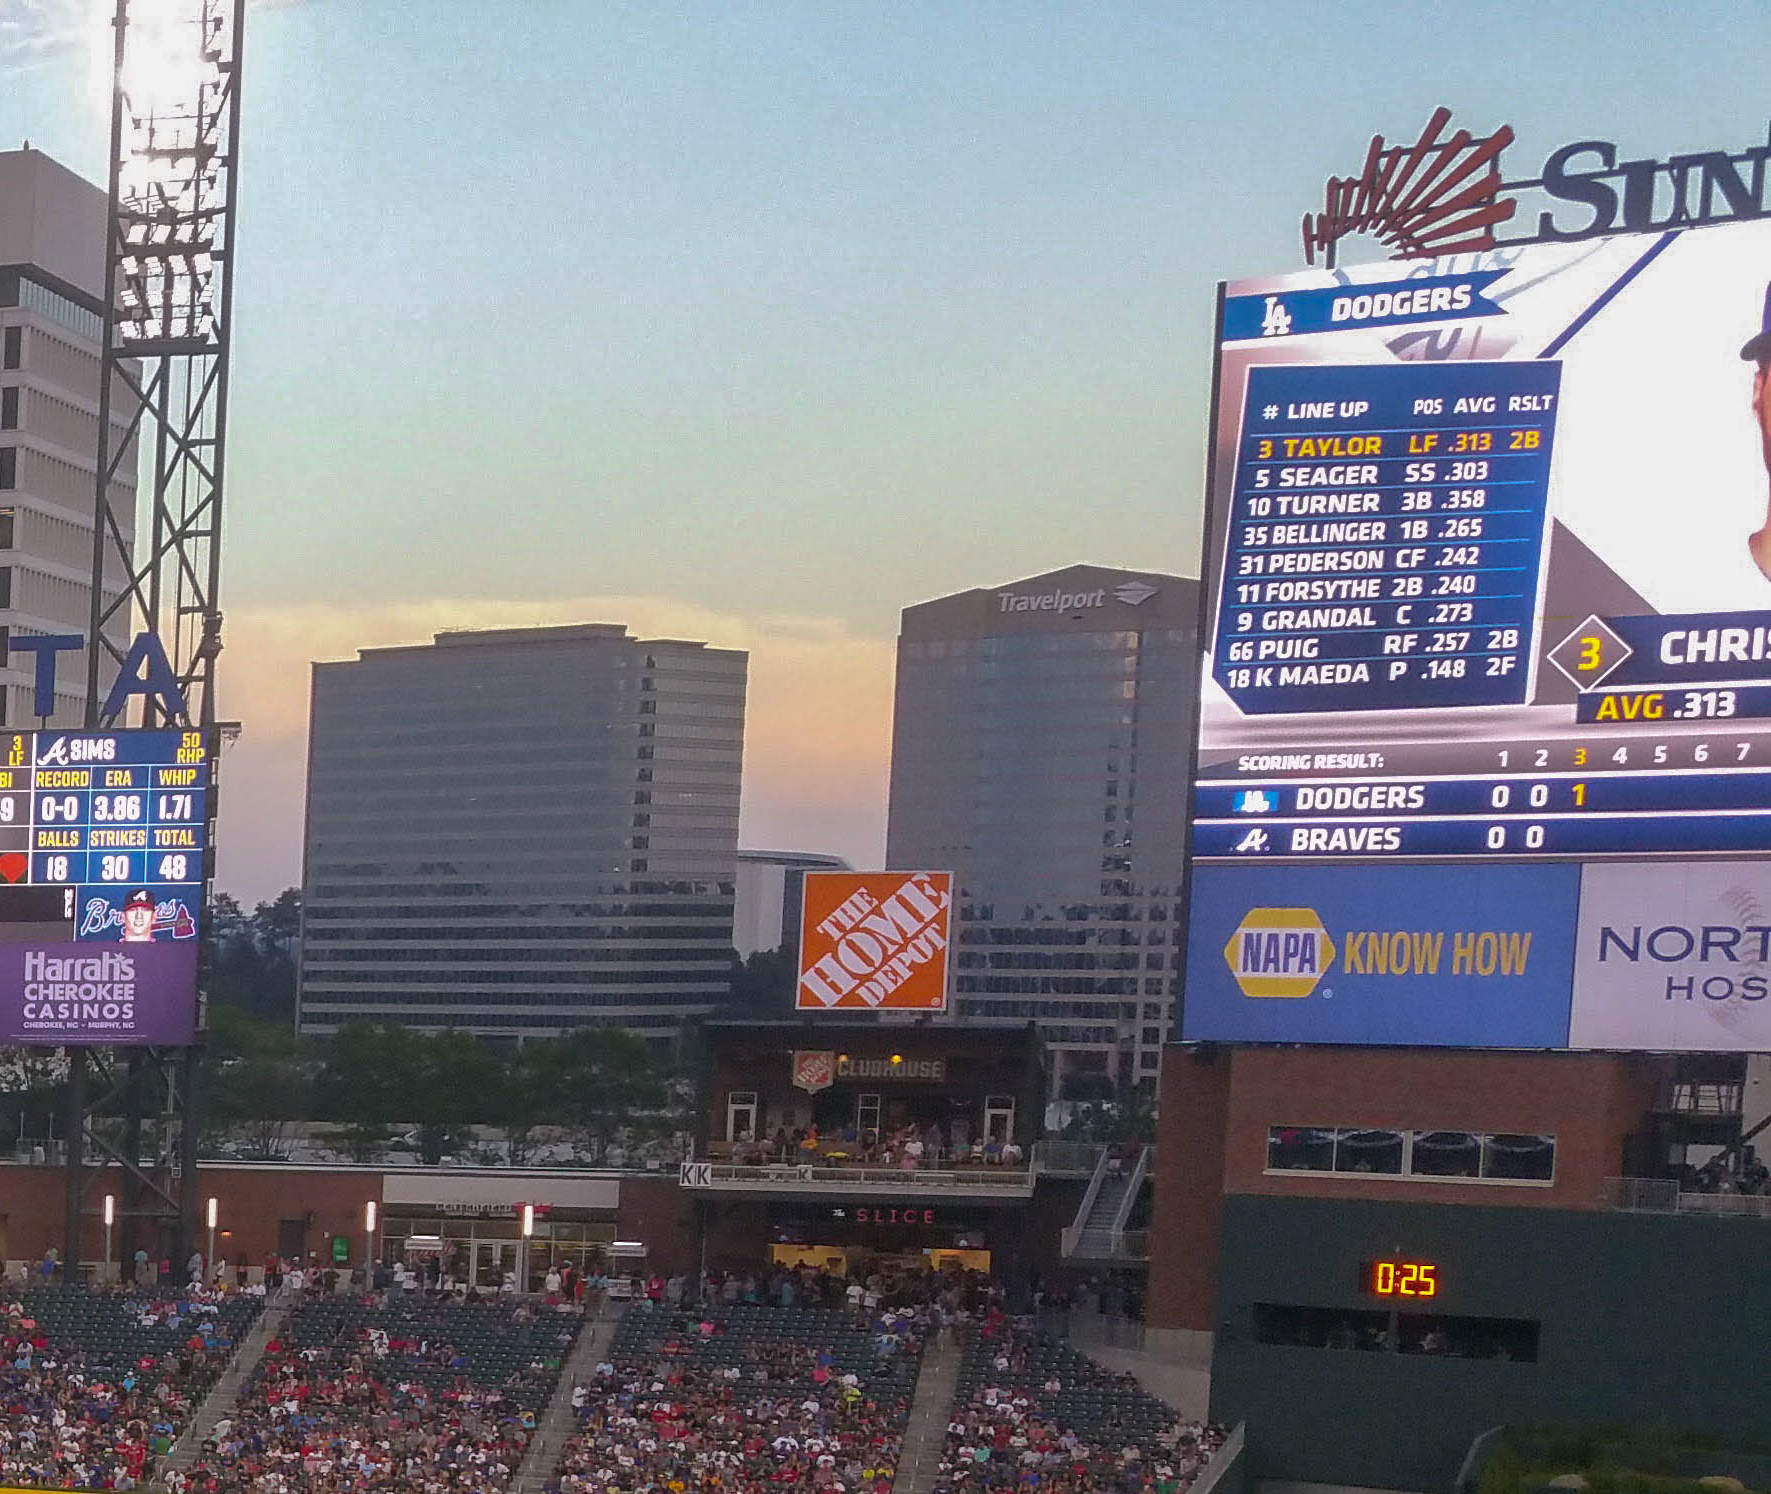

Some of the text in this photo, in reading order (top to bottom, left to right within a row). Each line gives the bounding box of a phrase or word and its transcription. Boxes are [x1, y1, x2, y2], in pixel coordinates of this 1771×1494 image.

[1332, 285, 1471, 321] DODGERS
[1289, 395, 1553, 418] LINE UP POS AVG RSLT
[1259, 431, 1539, 458] 3 TAYLOR LF .313 2B
[1256, 462, 1488, 487] 5 SEAGER SS .303
[1248, 490, 1485, 516] 10 TURNER 3B .358
[1244, 519, 1482, 545] 35 BELLINGER 1B .265
[998, 588, 1106, 614] Travelport
[1230, 629, 1518, 661] 66 PUIG RF .257 2B
[1578, 626, 1771, 671] 3 CHRI
[1596, 691, 1736, 720] AVG .313
[13, 736, 22, 750] 3
[71, 733, 200, 761] SIMS 50
[9, 751, 23, 766] LF
[176, 748, 204, 764] RHP
[1238, 751, 1384, 772] SCORING RESULT:
[36, 771, 88, 788] RECORD
[106, 771, 131, 786] ERA
[159, 770, 196, 786] WHIP
[42, 796, 78, 821] 0-0
[95, 795, 140, 821] 3.86
[159, 795, 191, 820] 1.71
[1296, 784, 1585, 811] DODGERS 0 0 1
[38, 831, 79, 847] BALLS
[90, 830, 146, 846] STRIKES
[154, 830, 195, 845] TOTAL
[1291, 825, 1543, 852] BRAVES 0 0
[47, 856, 67, 880] 18
[102, 856, 129, 880] 30
[159, 855, 186, 879] 48
[816, 886, 879, 941] THE
[800, 873, 949, 1007] HOME
[855, 923, 947, 1007] DEPOT
[1241, 931, 1318, 975] NAPA
[1344, 931, 1532, 976] KNOW HOW
[24, 983, 135, 1001] CHEROKEE
[24, 1003, 134, 1019] CASINOS
[837, 1059, 942, 1078] CLUBHOUSE
[858, 1209, 934, 1224] SLICE
[1376, 1262, 1436, 1297] 0:25
